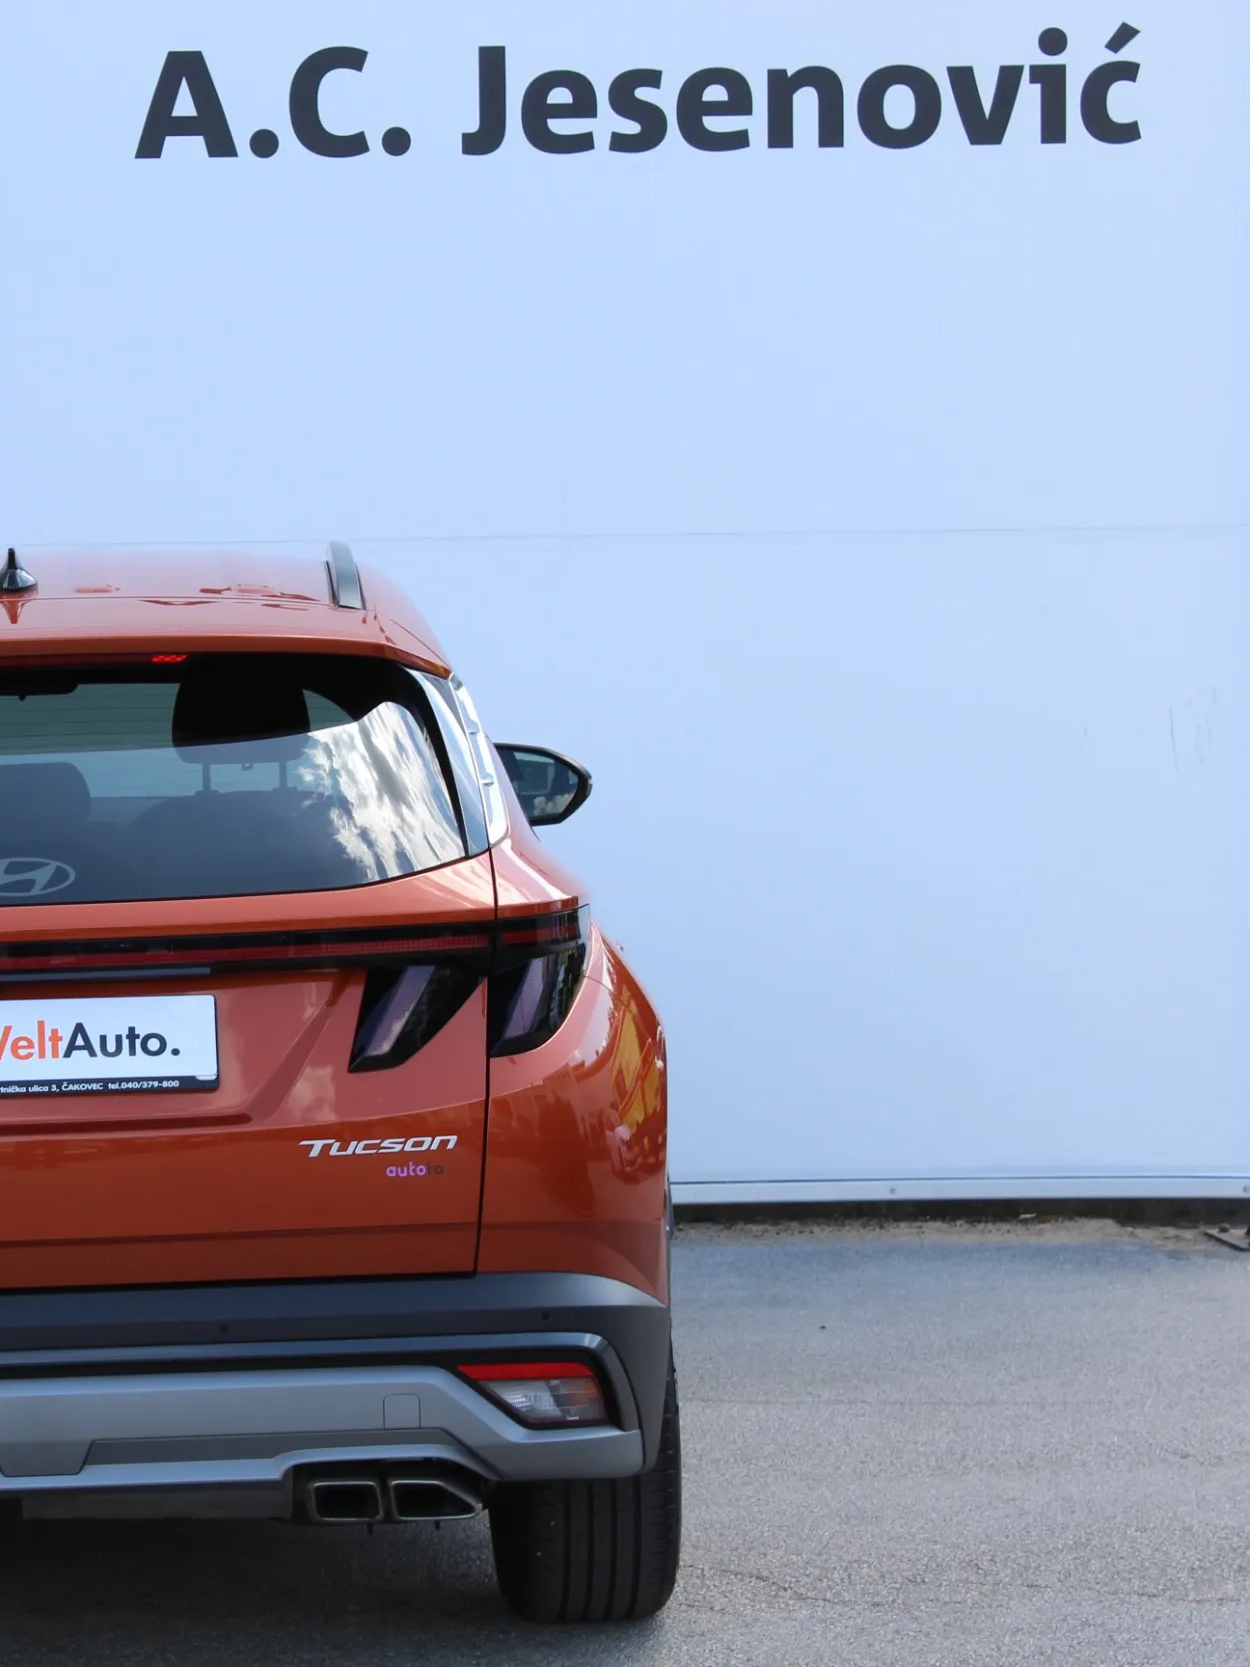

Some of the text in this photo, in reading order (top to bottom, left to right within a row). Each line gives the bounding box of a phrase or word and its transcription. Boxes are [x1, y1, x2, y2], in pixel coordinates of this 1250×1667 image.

[135, 22, 1141, 159] A.C. Jesenović
[29, 1084, 49, 1092] ulica
[50, 1084, 60, 1093] 3,
[62, 1081, 104, 1091] ČAKOVEC
